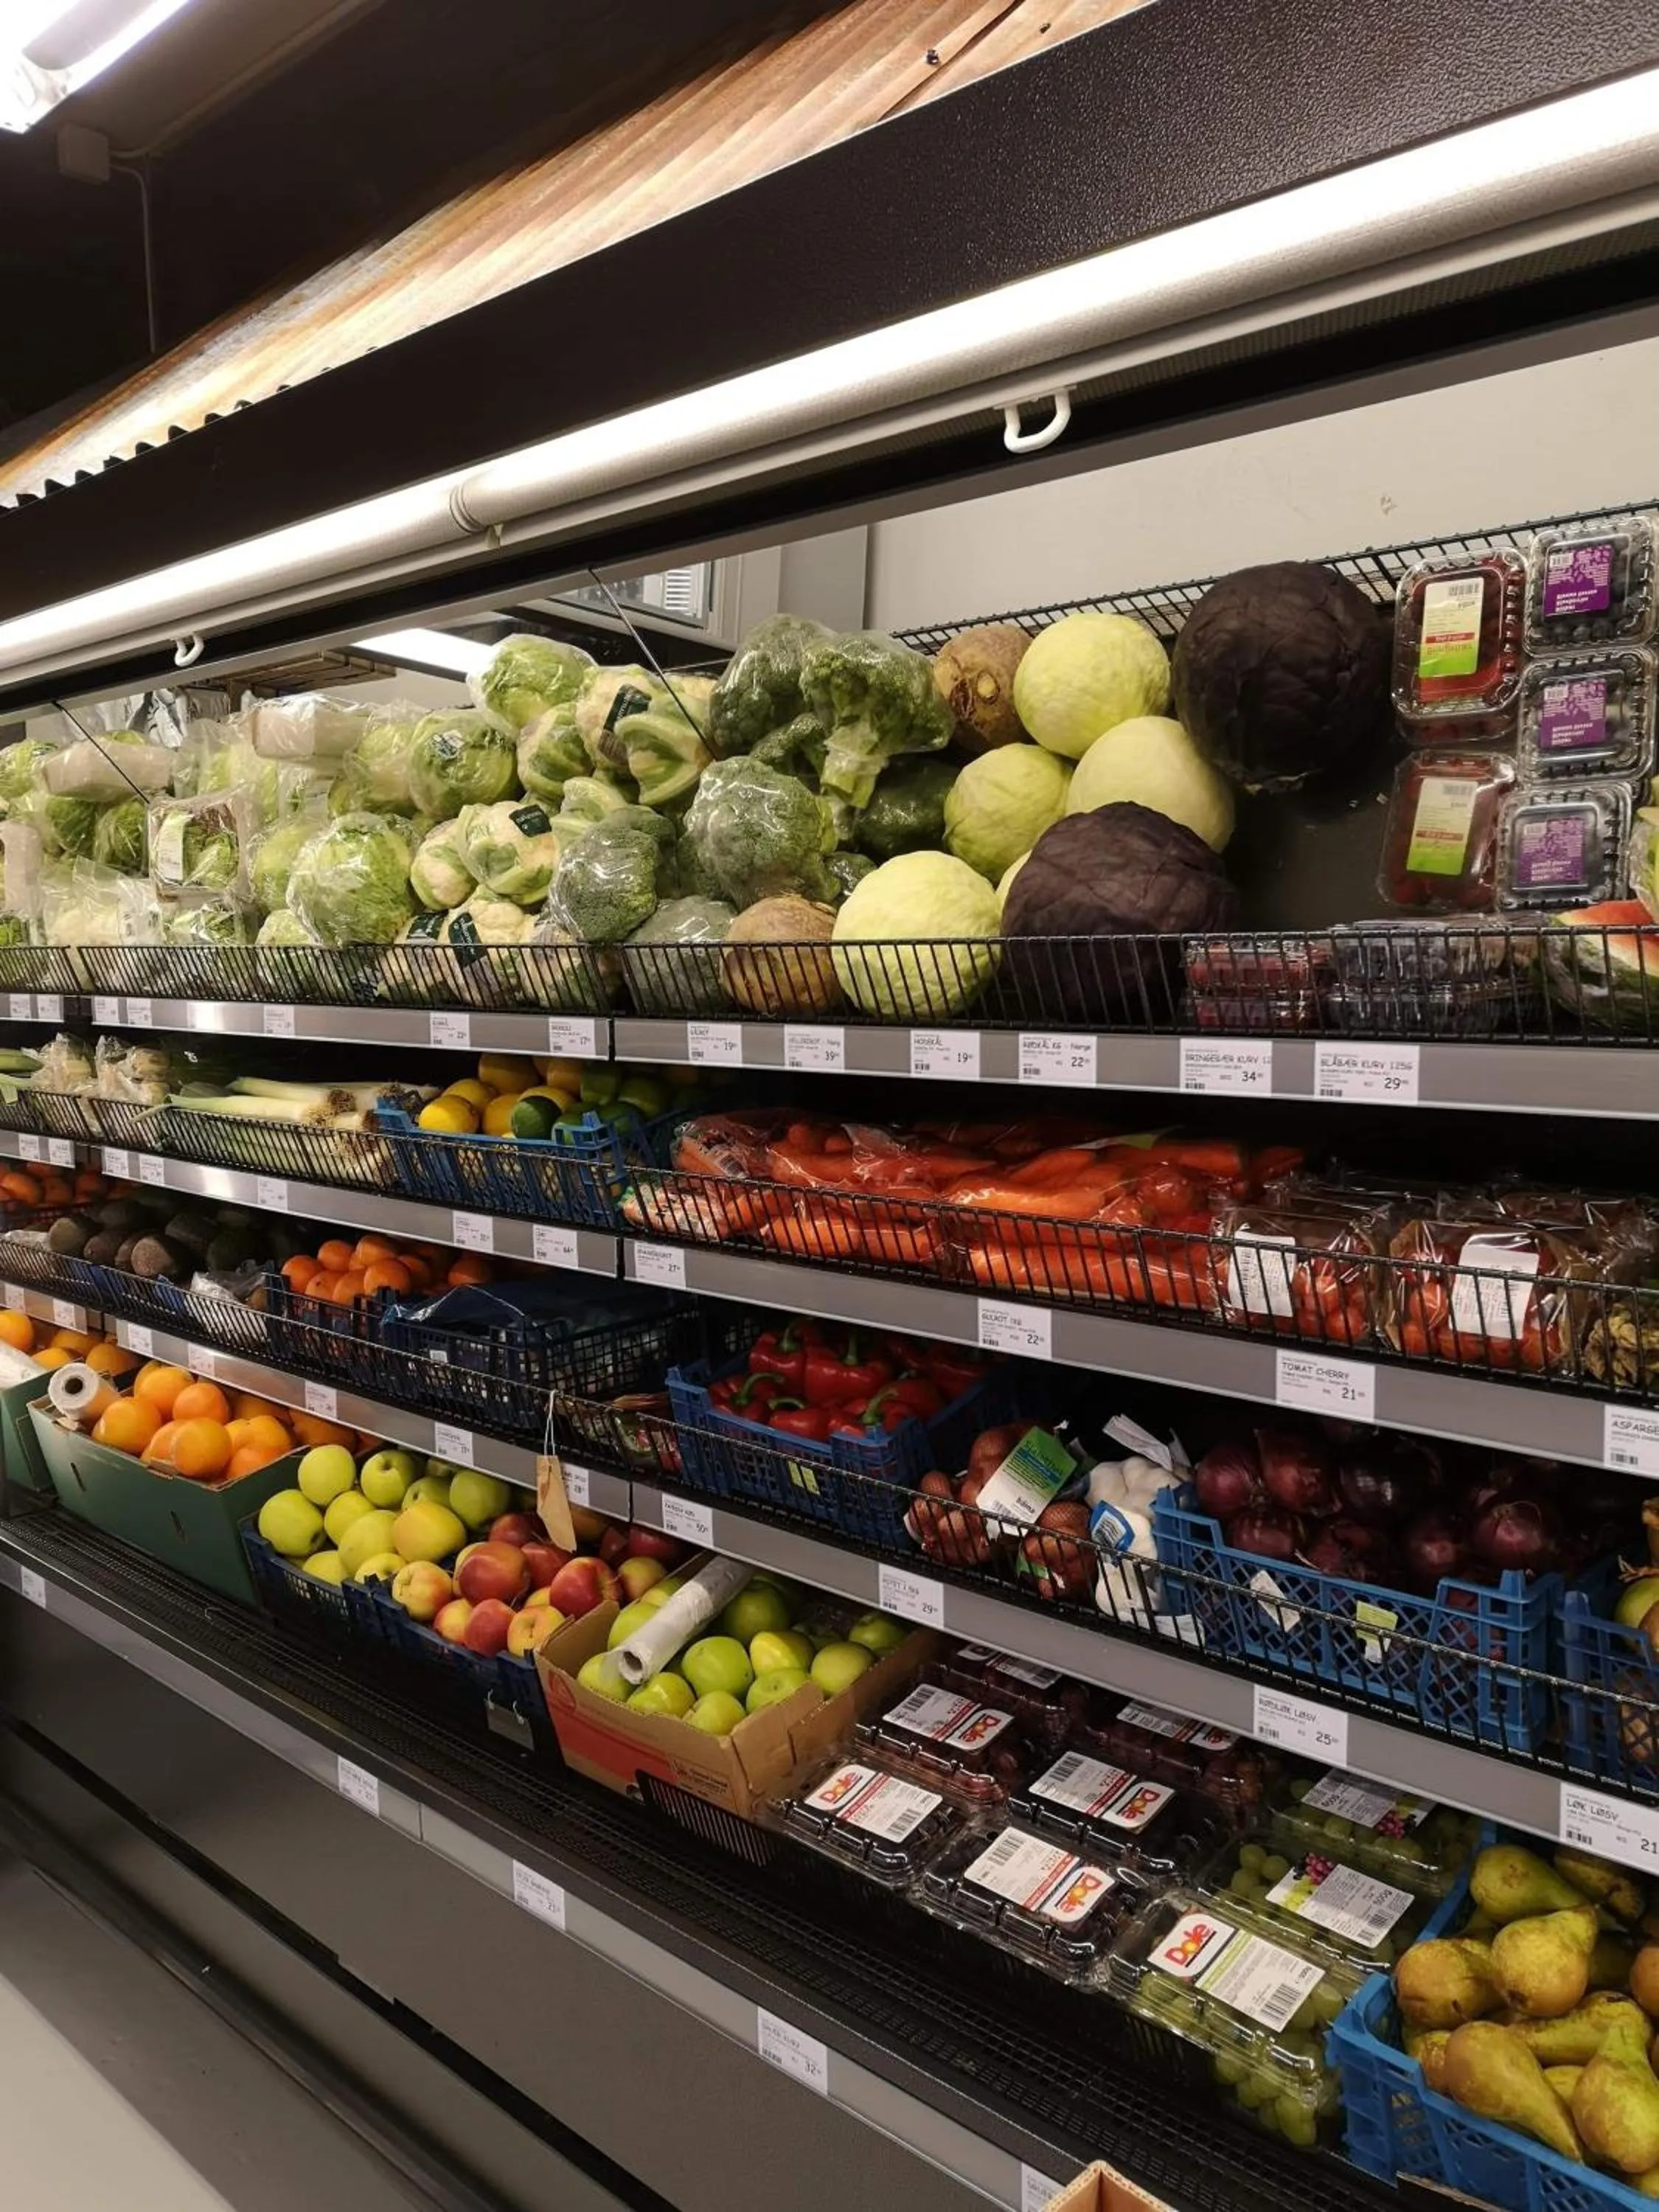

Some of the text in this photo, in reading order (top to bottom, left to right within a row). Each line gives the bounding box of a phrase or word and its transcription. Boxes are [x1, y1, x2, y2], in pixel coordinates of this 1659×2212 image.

[1242, 1071, 1256, 1082] 34
[1384, 1077, 1402, 1090] 29
[1026, 1334, 1040, 1346] 22
[1282, 1362, 1350, 1380] TOMAT CHERRY
[1341, 1387, 1356, 1400] 21
[1315, 1731, 1331, 1745] 25
[1641, 1838, 1658, 1854] 21
[1163, 1923, 1213, 1966] Dole
